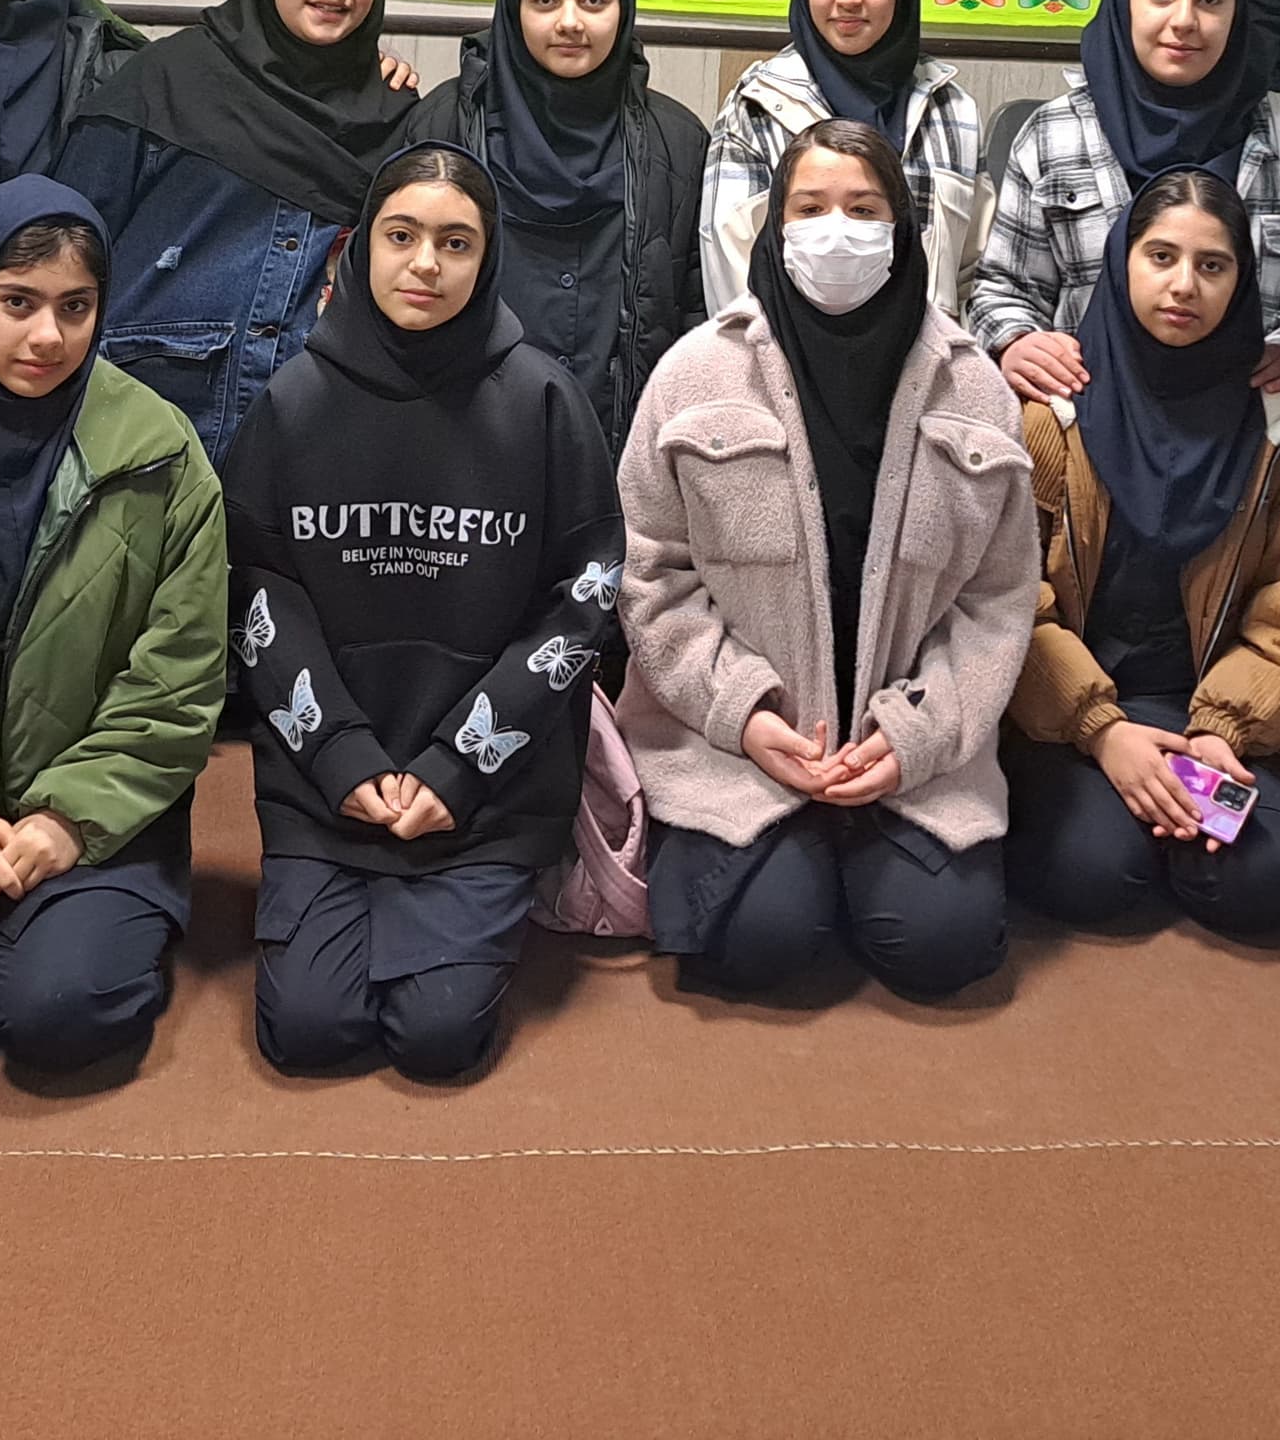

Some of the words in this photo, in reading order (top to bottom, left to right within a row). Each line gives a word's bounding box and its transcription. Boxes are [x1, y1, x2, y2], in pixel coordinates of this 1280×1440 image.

[291, 501, 527, 547] BUTTERFLY
[341, 546, 387, 563] BELIVE
[388, 546, 403, 559] IN
[406, 546, 469, 567] YOURSELF
[369, 561, 414, 576] STAND
[415, 563, 439, 579] OUT
